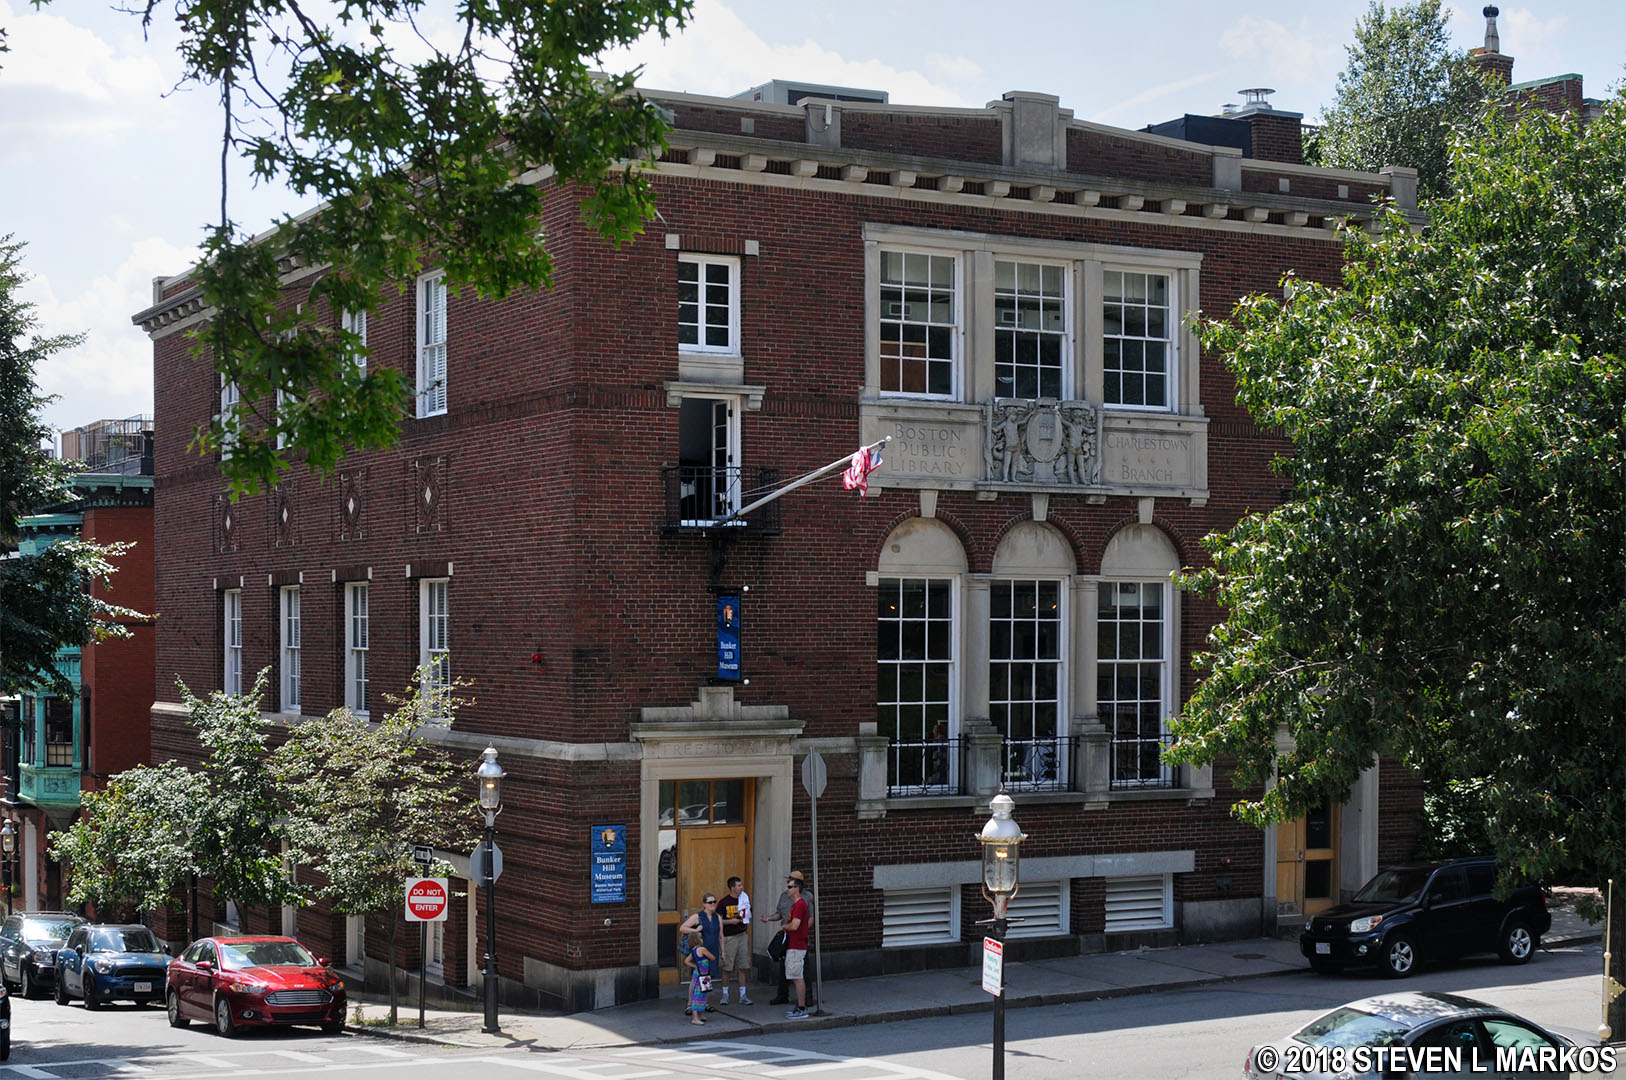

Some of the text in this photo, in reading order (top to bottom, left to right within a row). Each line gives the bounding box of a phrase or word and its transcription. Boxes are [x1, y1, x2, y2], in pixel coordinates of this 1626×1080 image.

[895, 423, 961, 441] BOSTON
[1105, 433, 1189, 452] CHARLESTOWN
[899, 441, 957, 458] PUBLIC
[890, 456, 966, 475] LIBRARY
[1121, 464, 1174, 483] BRANCH
[720, 641, 737, 650] Bunker
[596, 856, 622, 864] Bunker
[602, 864, 616, 872] Hill
[412, 888, 424, 896] DO
[415, 904, 439, 912] ENTER
